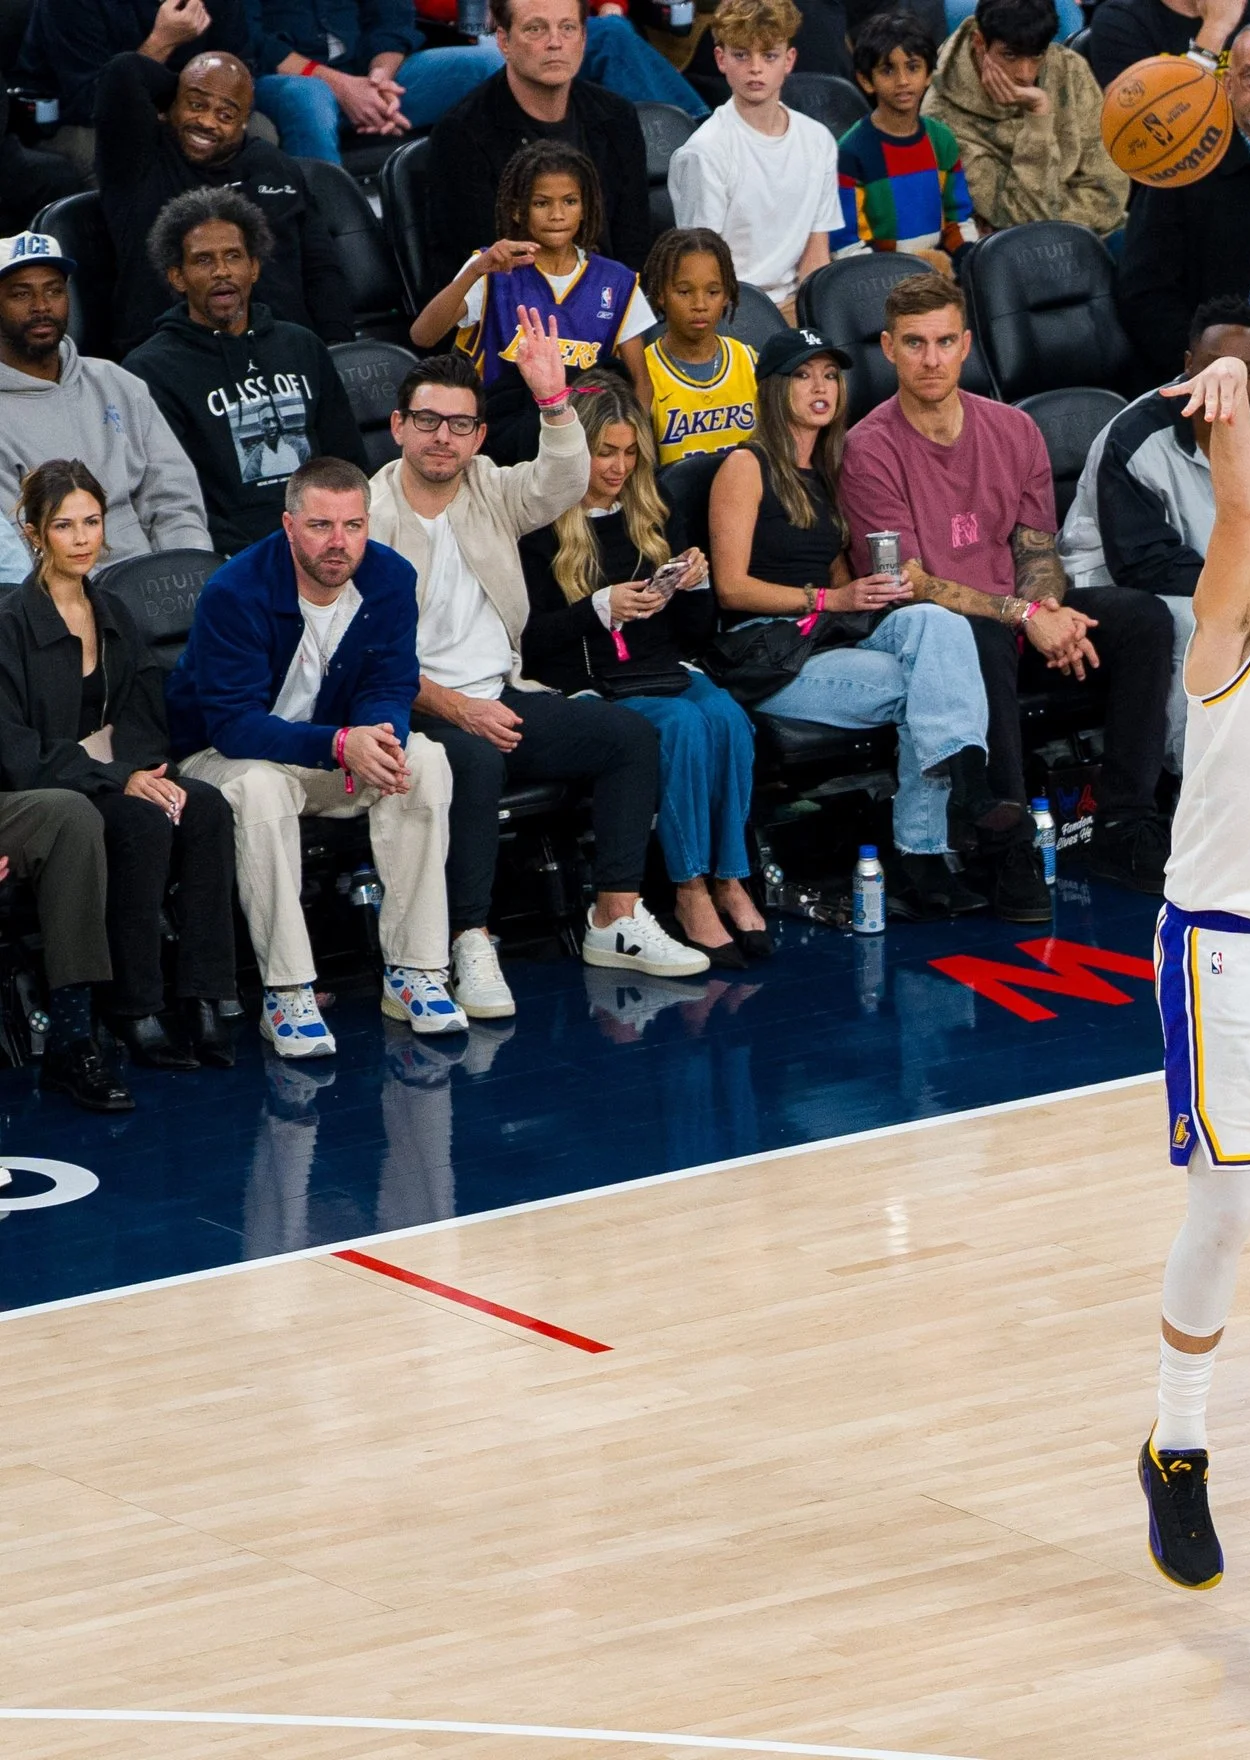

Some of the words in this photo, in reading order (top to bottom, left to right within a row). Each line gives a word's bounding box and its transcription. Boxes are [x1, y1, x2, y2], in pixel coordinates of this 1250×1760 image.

[10, 235, 50, 259] ACE
[498, 324, 602, 370] LERS
[800, 330, 823, 345] LA
[659, 402, 756, 445] LAKERS
[138, 571, 206, 597] INTUIT
[145, 593, 197, 617] DOM
